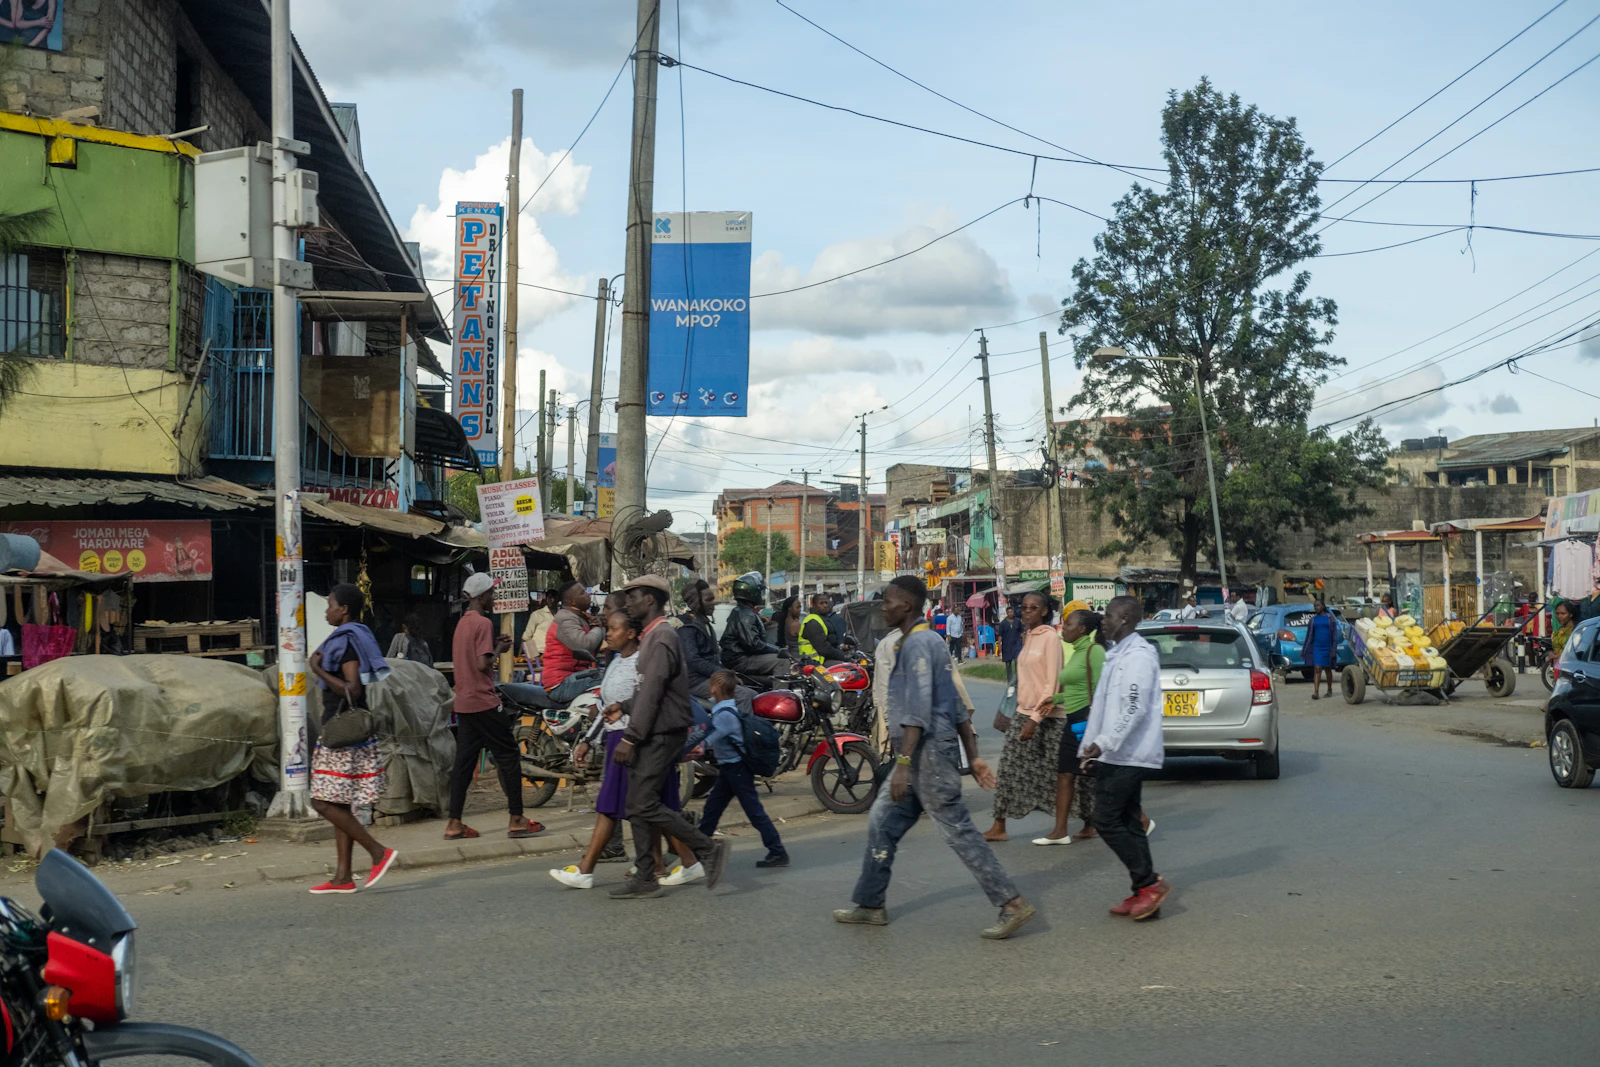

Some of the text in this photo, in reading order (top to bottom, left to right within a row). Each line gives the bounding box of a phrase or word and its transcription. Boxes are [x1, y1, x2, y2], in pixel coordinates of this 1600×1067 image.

[651, 298, 746, 312] WANAKOKO
[676, 314, 721, 328] MPO?
[458, 218, 487, 440] PETANNS
[485, 223, 497, 434] DRIVING SCHOOL
[480, 480, 537, 494] MUSIC CLASSES
[73, 528, 150, 538] JOMARI MEGA
[489, 524, 520, 533] SAXOPHONE
[80, 539, 144, 548] HARDWARE
[492, 558, 525, 568] SCHOOL
[493, 590, 528, 600] BEGINNERS
[1169, 704, 1196, 714] 195Y
